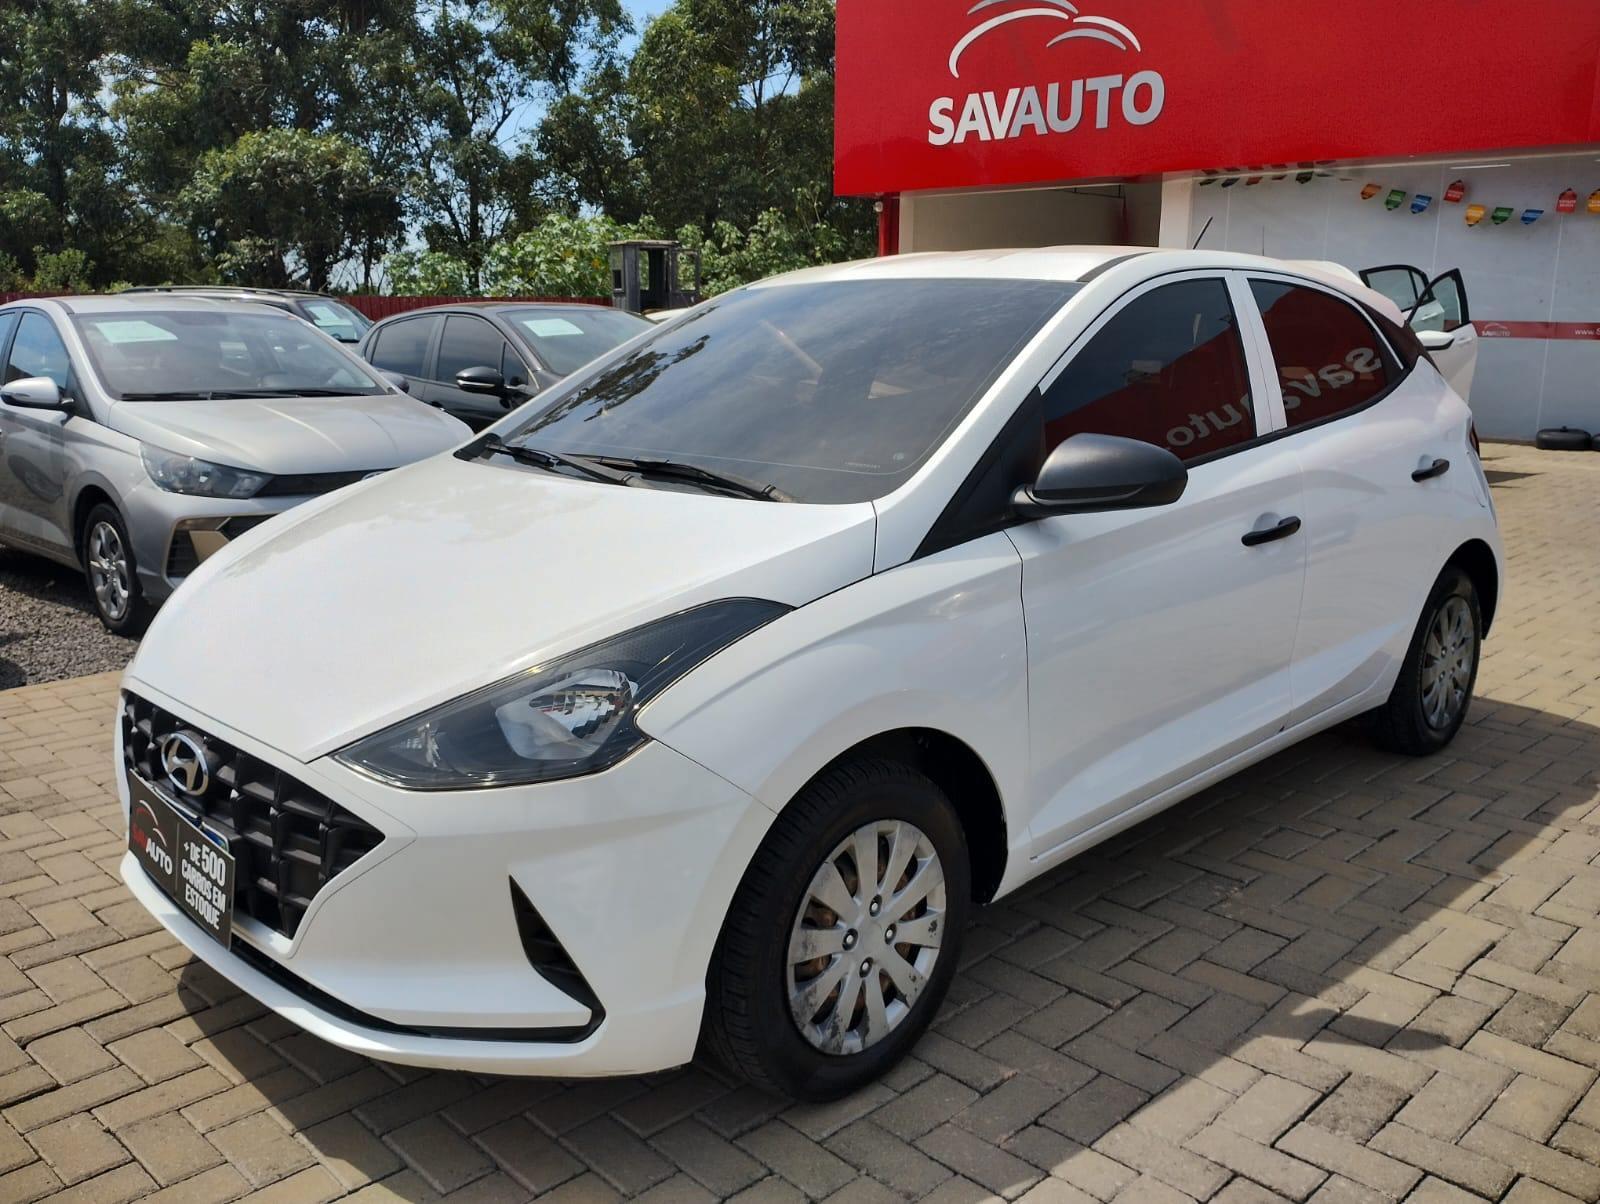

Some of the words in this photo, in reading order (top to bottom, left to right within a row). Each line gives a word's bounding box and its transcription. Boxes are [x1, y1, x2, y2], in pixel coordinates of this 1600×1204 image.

[928, 70, 1165, 146] SAVAUTO
[181, 859, 213, 898] CARROS
[212, 887, 226, 913] EM
[190, 842, 201, 866] DE
[201, 844, 226, 887] 500
[185, 883, 220, 930] ESTOQUE
